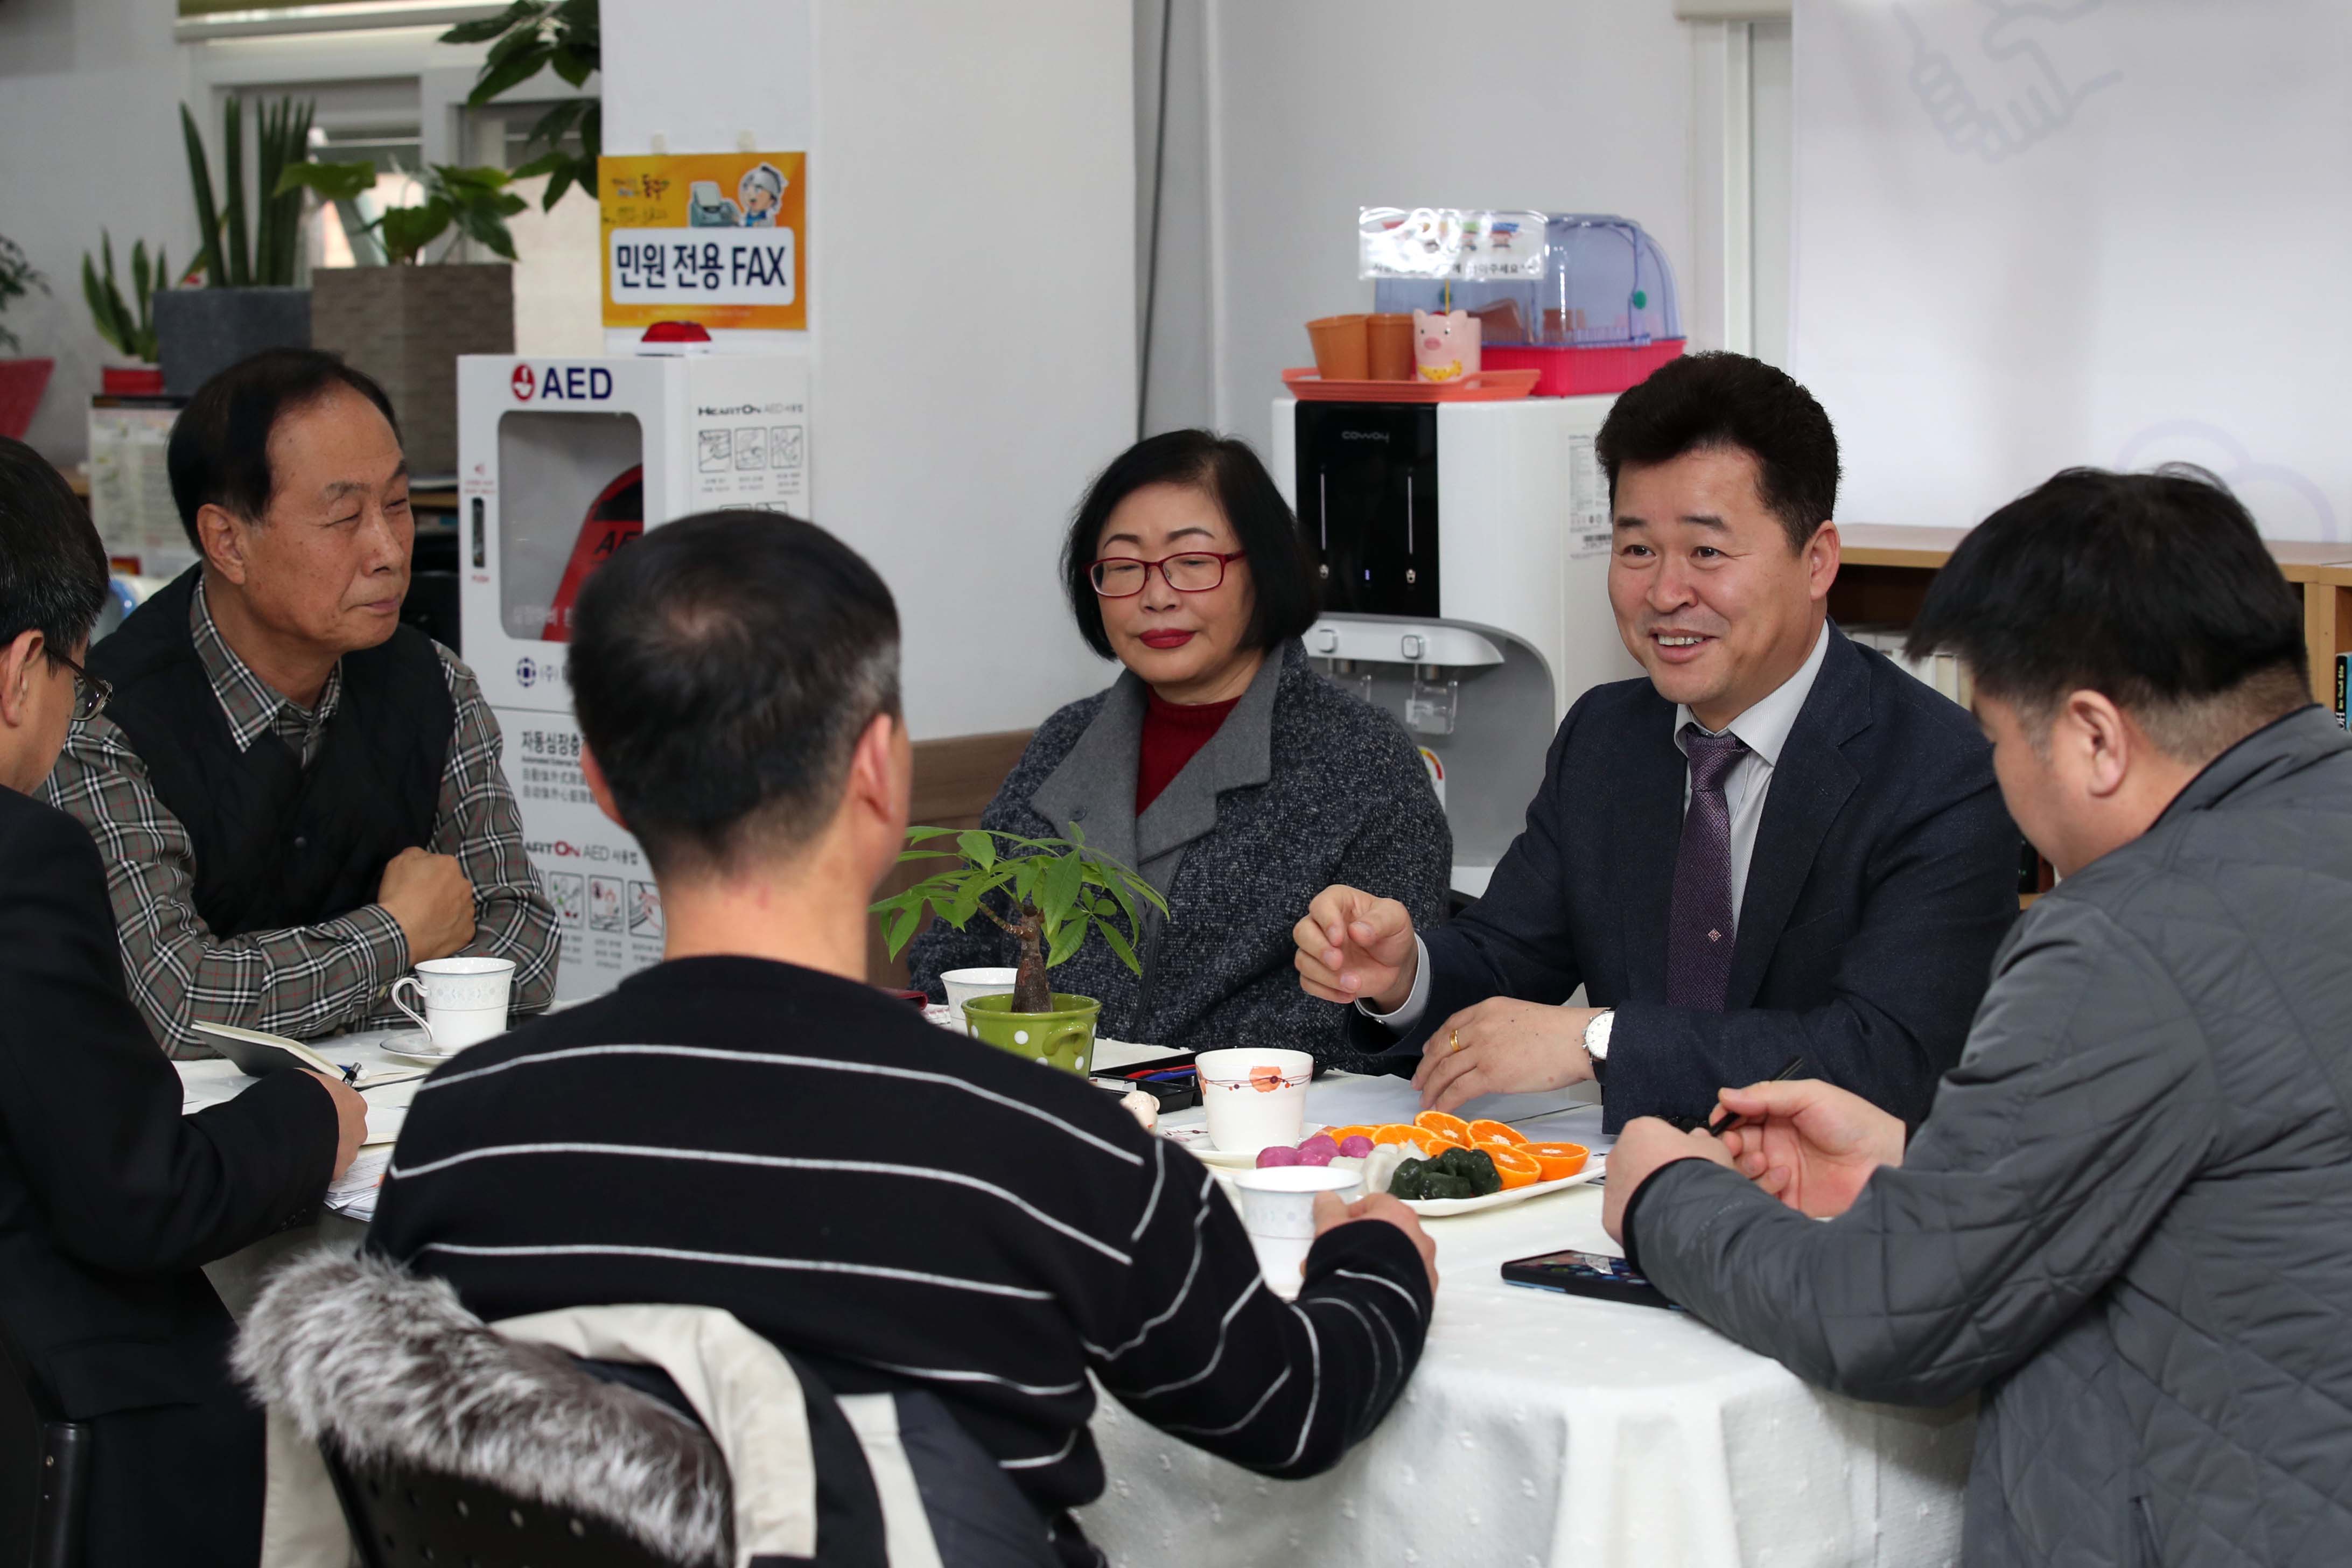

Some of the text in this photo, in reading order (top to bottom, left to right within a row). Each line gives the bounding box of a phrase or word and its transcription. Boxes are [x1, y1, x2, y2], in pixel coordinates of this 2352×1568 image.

[618, 242, 786, 290] 민원 전용 FAX
[541, 367, 613, 400] AED
[522, 731, 585, 757] 자동심장충
